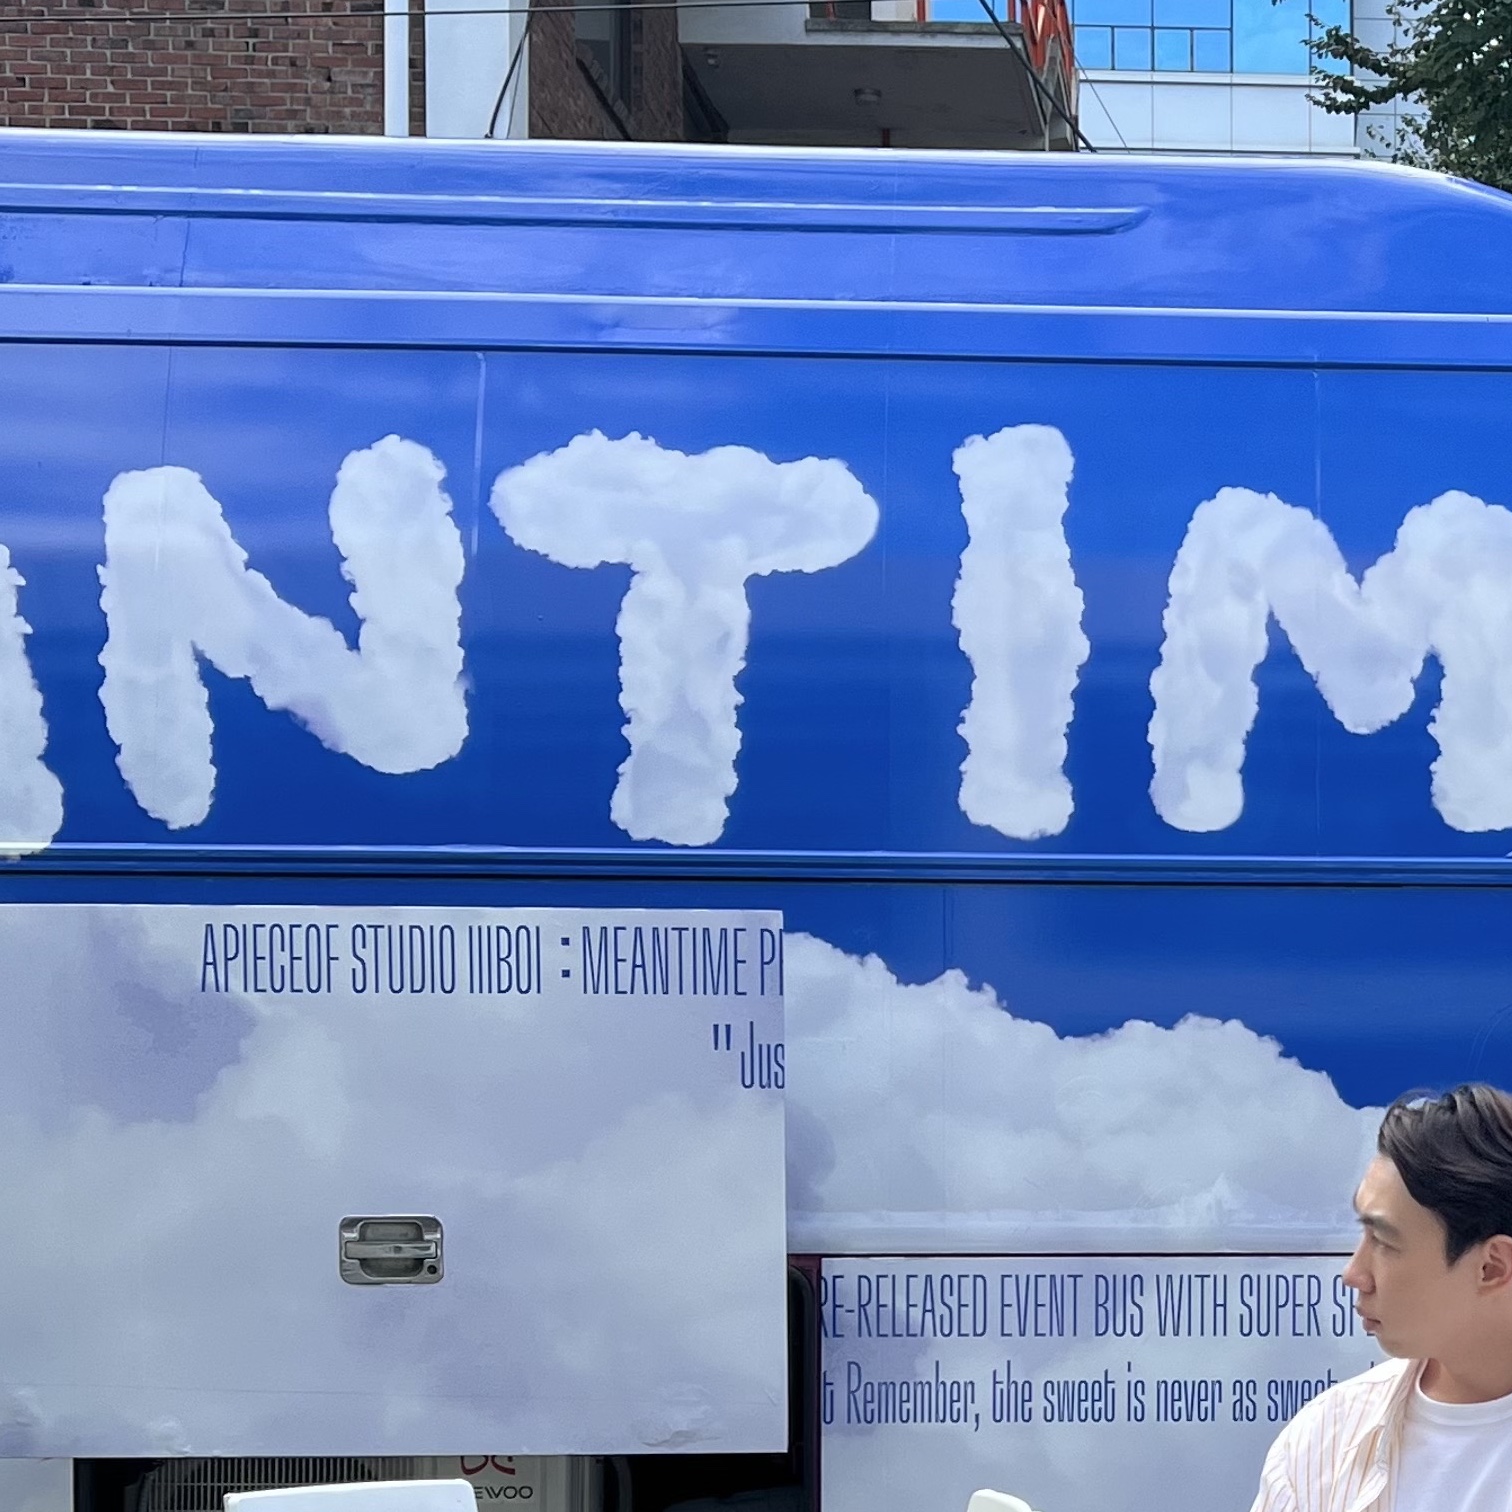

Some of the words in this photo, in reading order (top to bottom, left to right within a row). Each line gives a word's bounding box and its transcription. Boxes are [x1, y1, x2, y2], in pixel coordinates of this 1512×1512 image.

[201, 923, 340, 993] APIECEOF
[351, 923, 456, 995] STUDIO
[582, 926, 747, 996] MEANTIME
[1000, 1274, 1084, 1337] EVENT
[1094, 1274, 1144, 1337] BUS
[1155, 1274, 1228, 1337] WITH
[1239, 1273, 1322, 1337] SUPER
[846, 1360, 980, 1432] Remember,
[992, 1359, 1033, 1424] the
[1043, 1368, 1116, 1424] sweet
[1126, 1361, 1146, 1423] is
[1156, 1378, 1223, 1423] never
[1232, 1378, 1257, 1423] as
